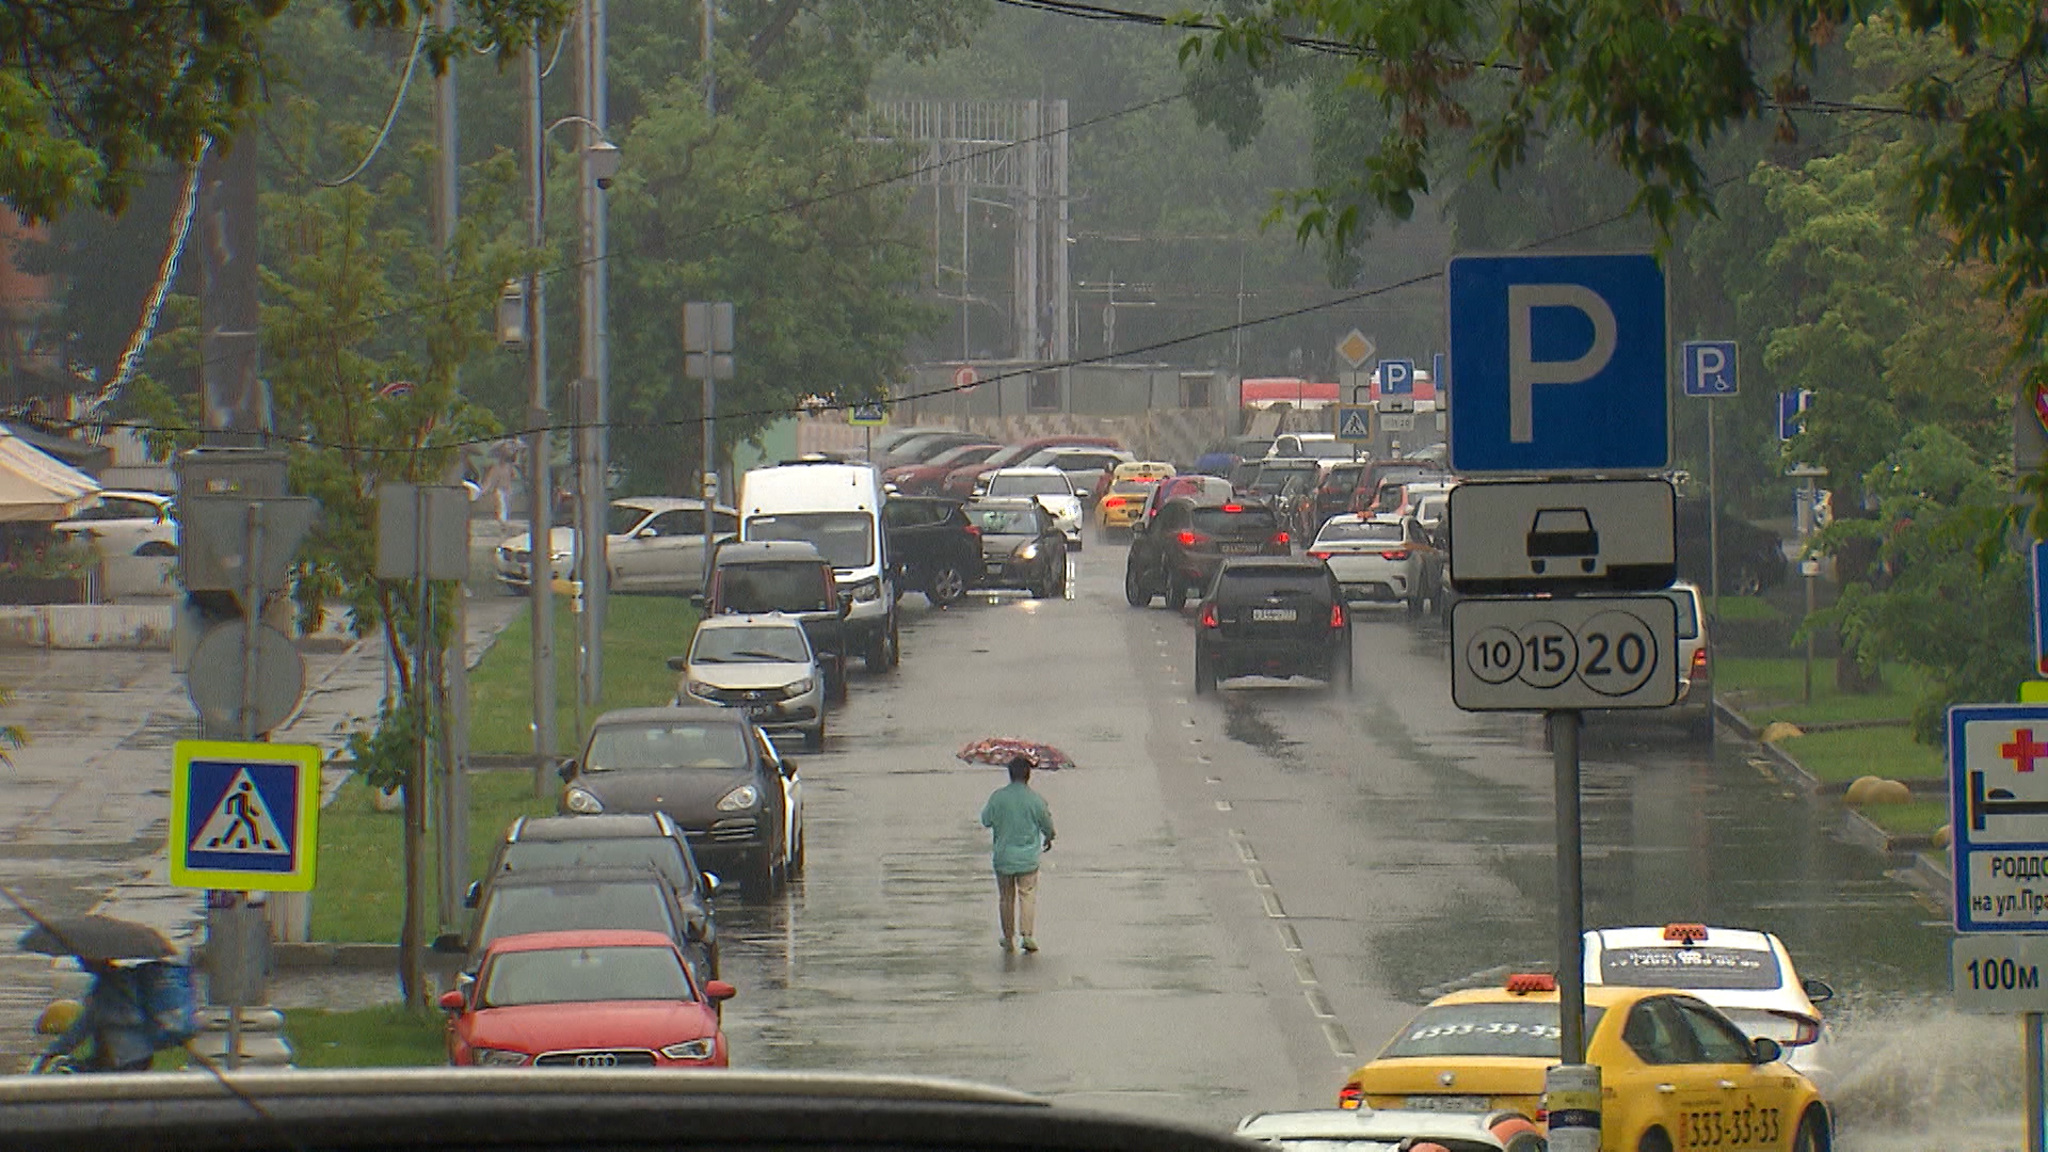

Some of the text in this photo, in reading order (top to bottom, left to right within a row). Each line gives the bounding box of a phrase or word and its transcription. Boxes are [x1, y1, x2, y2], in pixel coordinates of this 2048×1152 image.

[1387, 364, 1407, 392] P
[1508, 283, 1617, 443] P
[1696, 347, 1725, 388] P
[1477, 632, 1646, 675] 10 15 20
[1972, 894, 1992, 911] на
[1966, 958, 2039, 990] 100м
[1689, 1107, 1779, 1148] 333-33-33
